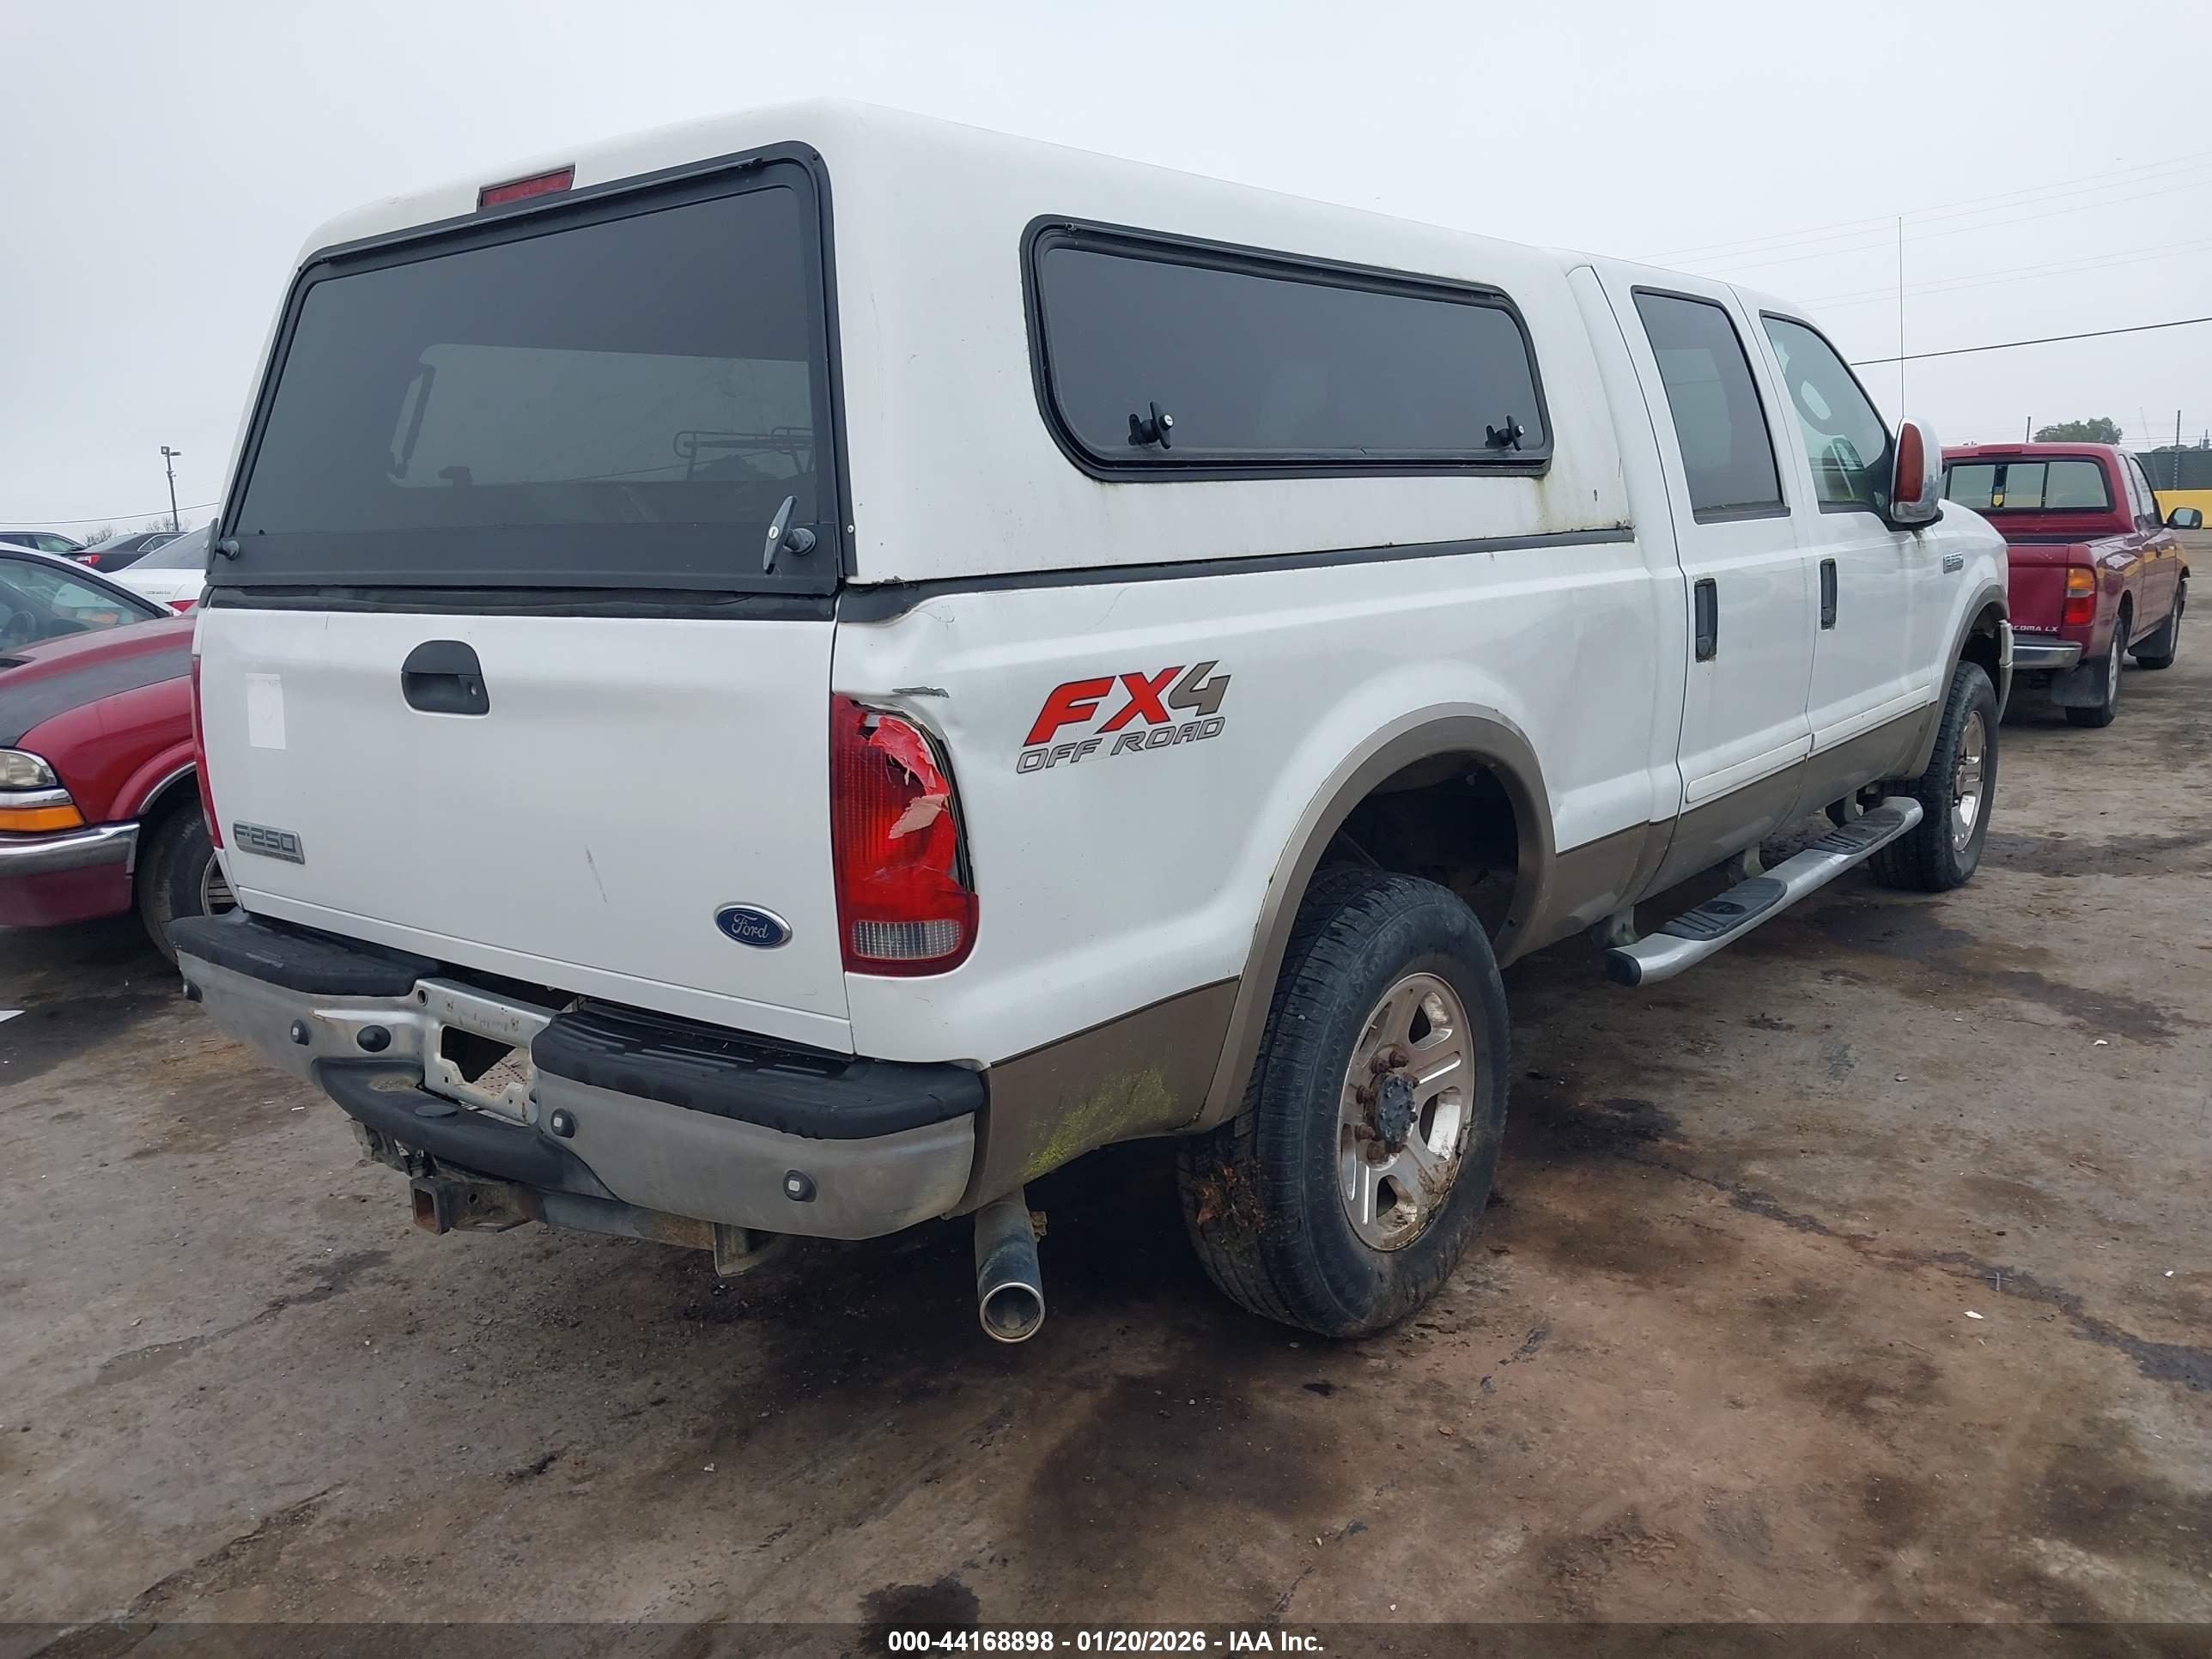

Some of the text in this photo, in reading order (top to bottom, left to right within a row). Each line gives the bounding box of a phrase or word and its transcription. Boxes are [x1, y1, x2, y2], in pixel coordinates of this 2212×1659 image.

[1023, 659, 1231, 747] FX4
[1017, 716, 1225, 775] OFF ROAD
[731, 913, 769, 939] Ford
